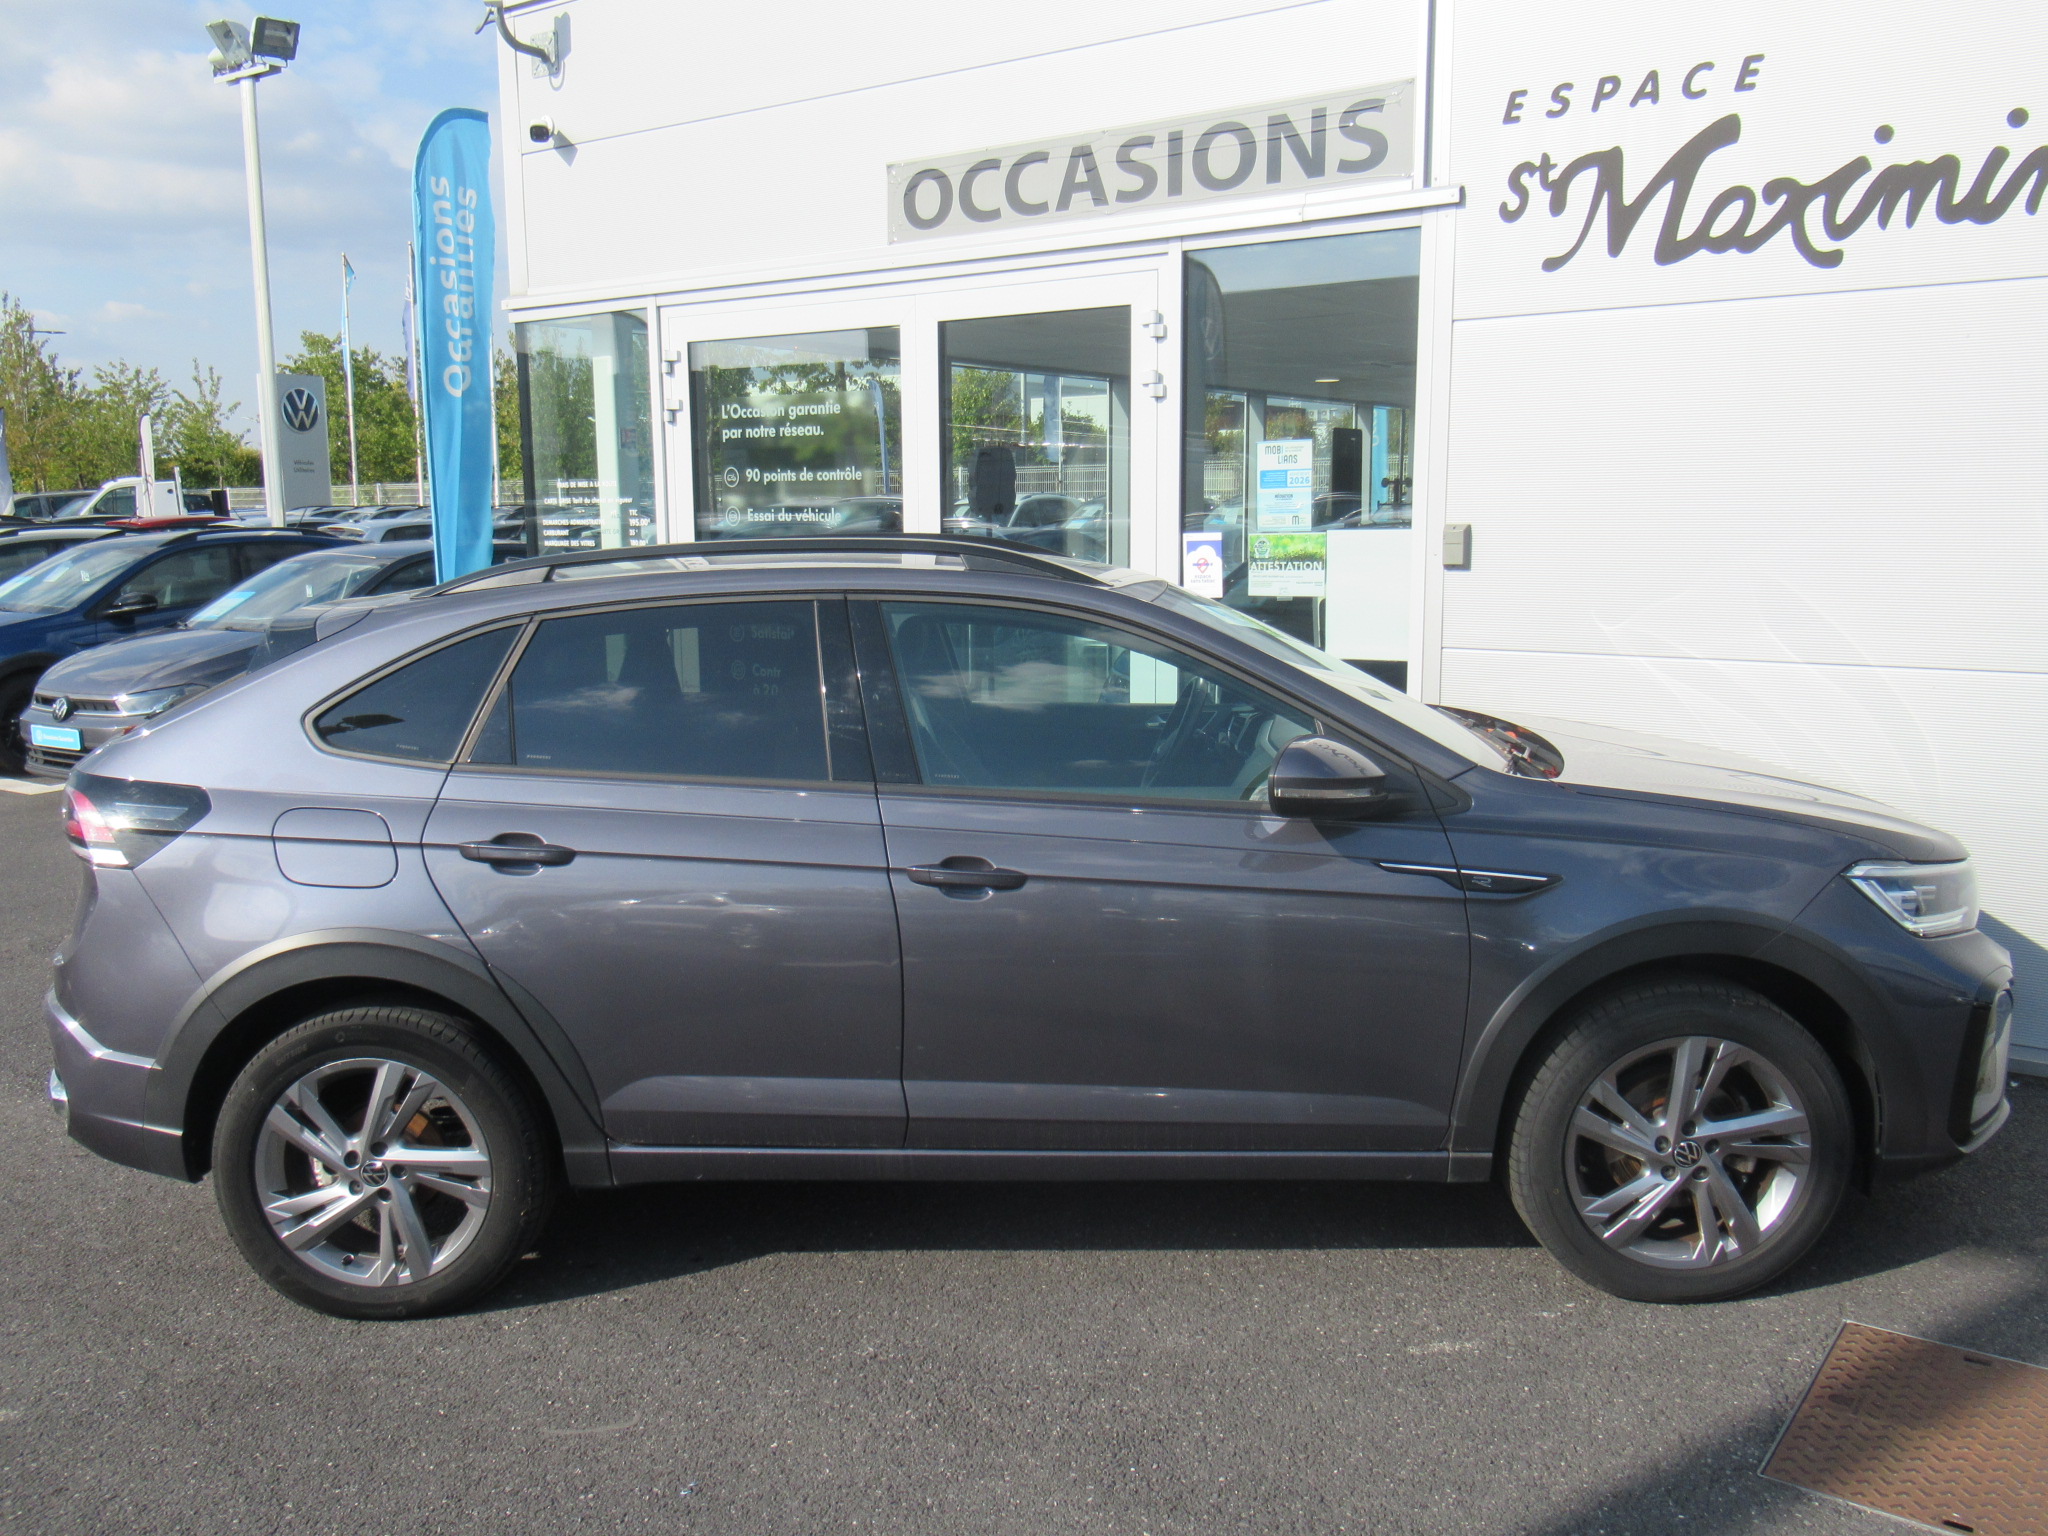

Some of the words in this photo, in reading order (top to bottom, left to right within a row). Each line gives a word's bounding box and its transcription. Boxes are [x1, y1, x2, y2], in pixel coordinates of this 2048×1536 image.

[1502, 53, 1765, 125] ESPACE
[903, 98, 1389, 231] OCCASIONS
[430, 175, 463, 398] Occasions
[788, 401, 841, 420] garantie
[722, 427, 744, 442] par
[745, 425, 776, 438] notre
[779, 423, 824, 437] réseau.
[745, 469, 761, 482] 90
[763, 469, 797, 485] points
[799, 468, 814, 482] de
[816, 466, 863, 482] contrôle
[1289, 476, 1311, 485] 2026
[747, 508, 775, 522] Essai
[778, 508, 792, 522] du
[795, 508, 842, 523] véhicule
[1251, 561, 1322, 571] ATTESTATION
